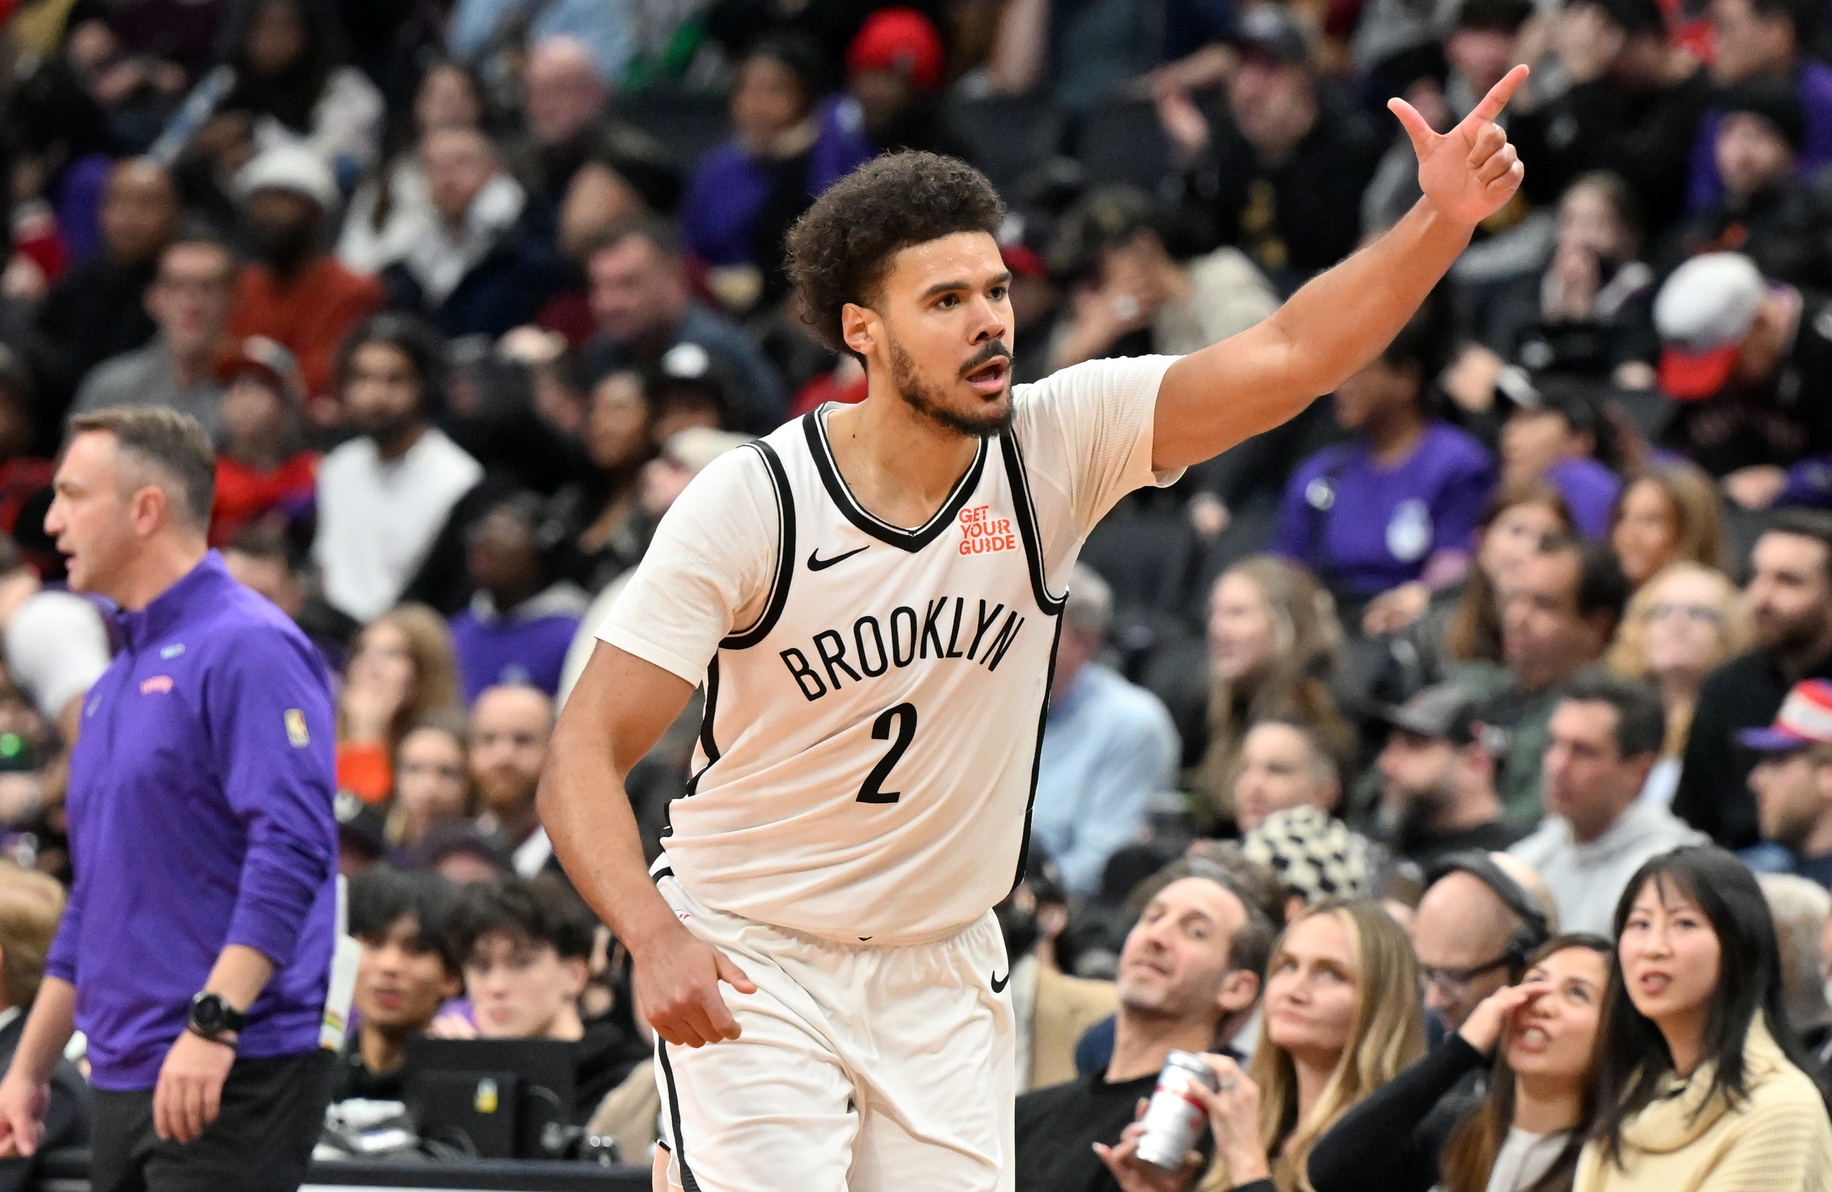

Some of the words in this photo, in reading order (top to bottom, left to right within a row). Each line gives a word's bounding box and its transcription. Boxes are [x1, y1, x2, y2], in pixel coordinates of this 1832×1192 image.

[959, 505, 989, 523] GET
[960, 519, 1011, 539] YOUR
[959, 535, 1016, 555] GUIDE
[779, 596, 1025, 702] BROOKLYN
[855, 702, 918, 804] 2
